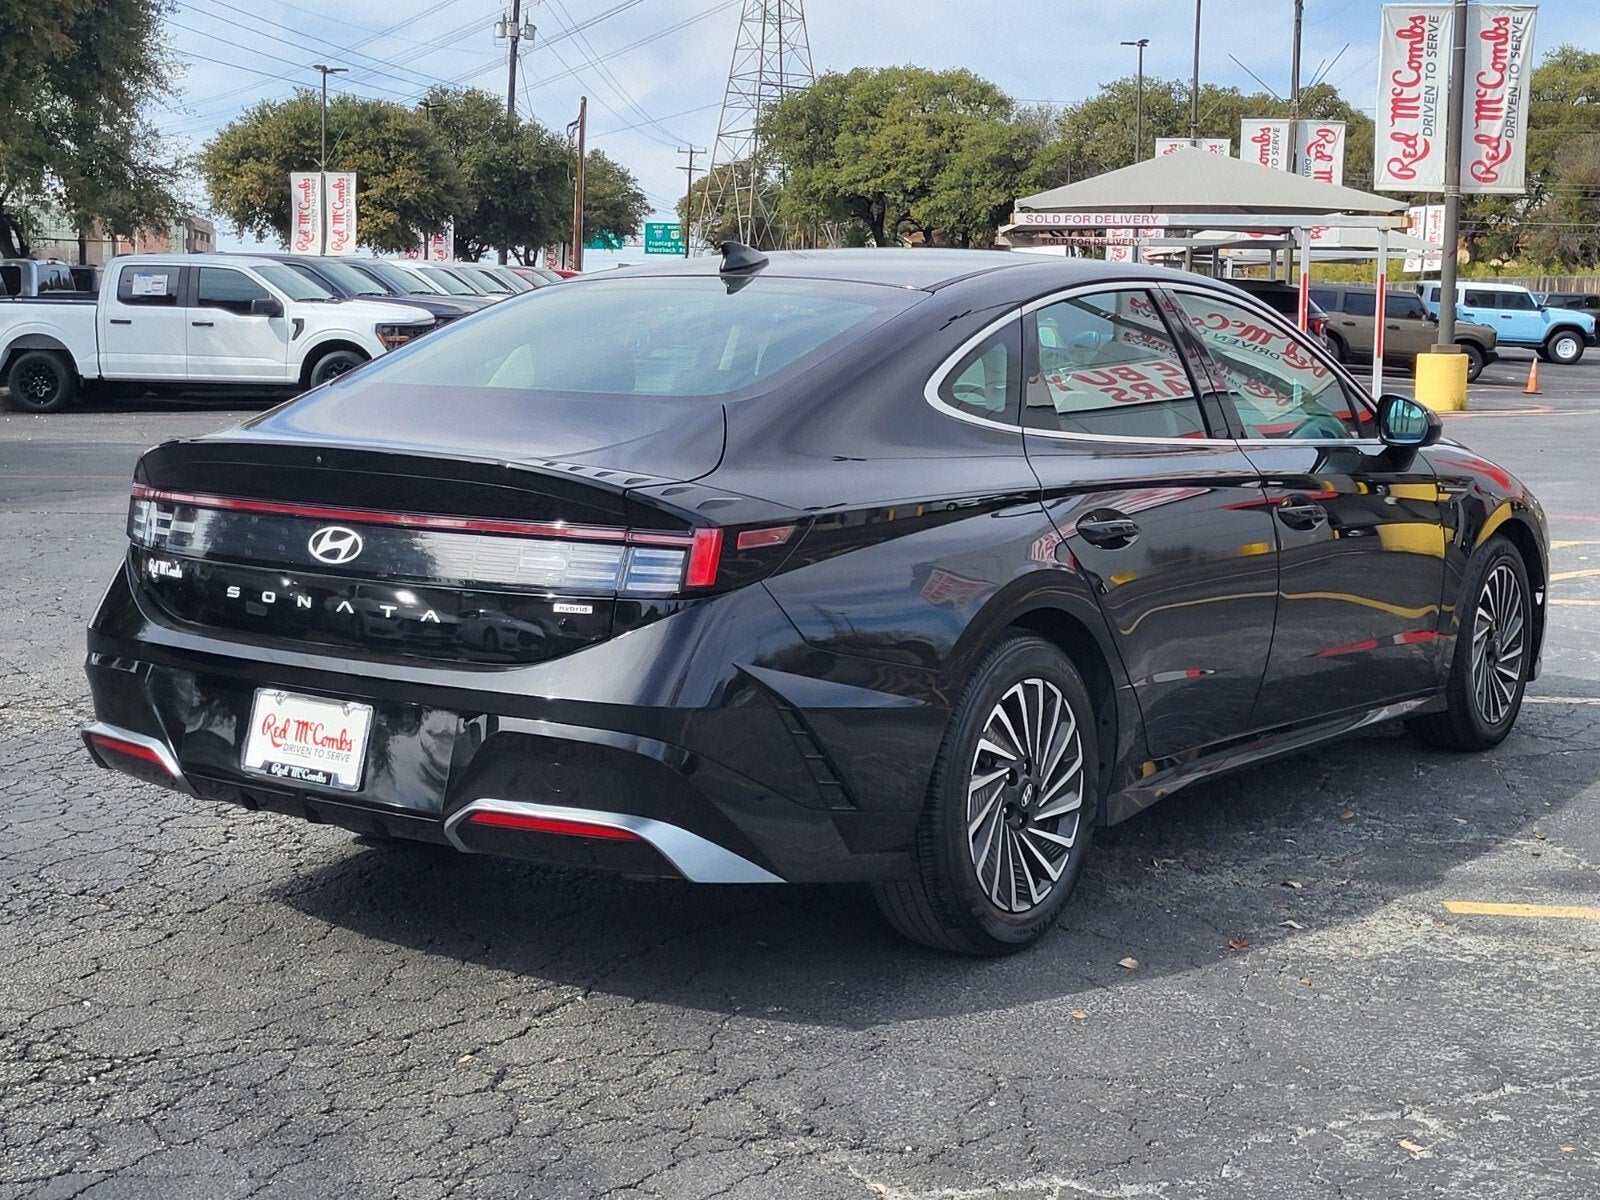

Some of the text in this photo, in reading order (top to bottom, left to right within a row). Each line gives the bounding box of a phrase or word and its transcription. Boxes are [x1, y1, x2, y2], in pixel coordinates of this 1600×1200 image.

[1423, 15, 1439, 137] DRIVEN TO SERVE
[1505, 16, 1523, 139] DRIVEN TO SERVE
[1387, 14, 1430, 180] Red McCombs
[1470, 16, 1511, 183] Red McCombs
[1271, 126, 1280, 156] SERVE
[1306, 128, 1336, 162] Red
[295, 178, 314, 251] Red McCombs
[331, 177, 349, 251] Red McCombs
[1025, 214, 1159, 224] SOLD FOR DELIVERY
[1041, 238, 1142, 246] SOLD FOR DELIVERY
[226, 585, 441, 623] SONATA
[559, 605, 588, 613] hybrid
[262, 713, 353, 752] Red McCombs
[282, 743, 352, 763] DRIVEN TO SERVE
[271, 762, 327, 784] Red McCombs
